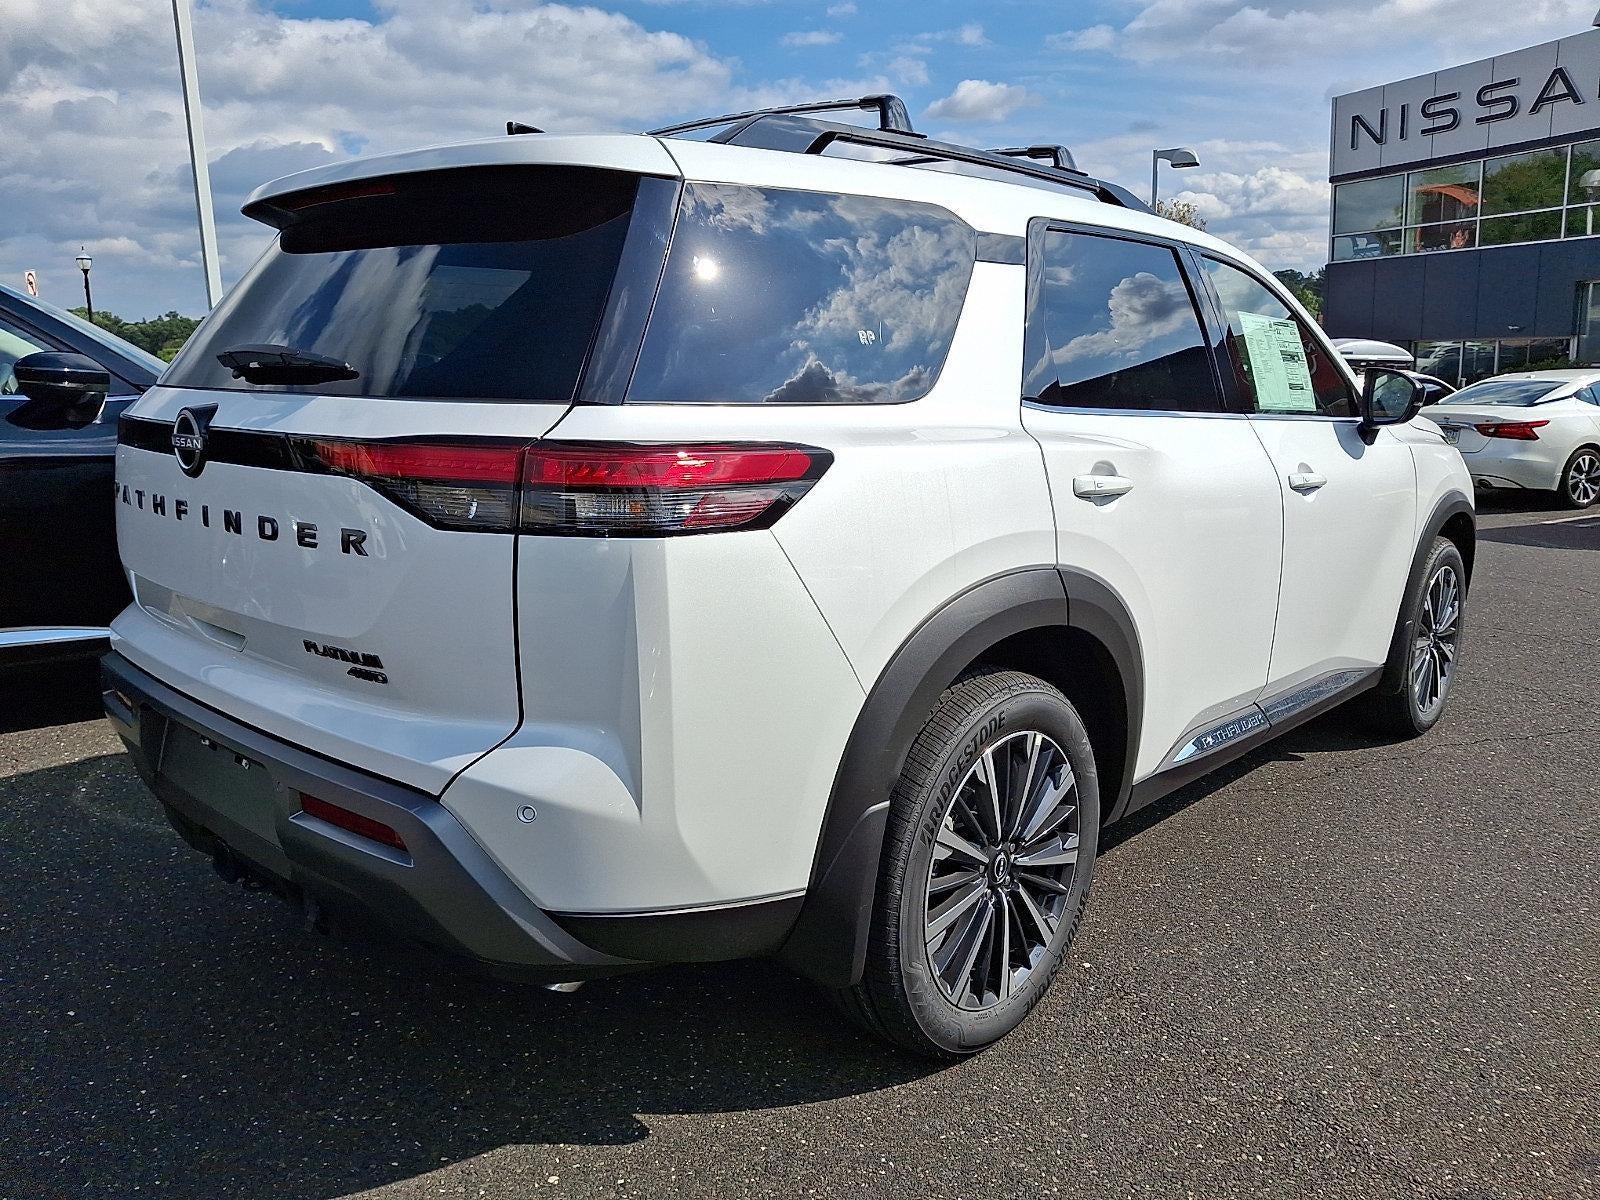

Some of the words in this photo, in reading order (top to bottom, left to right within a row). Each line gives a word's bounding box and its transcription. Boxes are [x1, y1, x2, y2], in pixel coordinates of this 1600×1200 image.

[1350, 66, 1600, 151] NISSA
[172, 434, 203, 450] SSAN
[1201, 714, 1265, 749] PATHFINDER
[920, 710, 1006, 849] BRIDGESTONE
